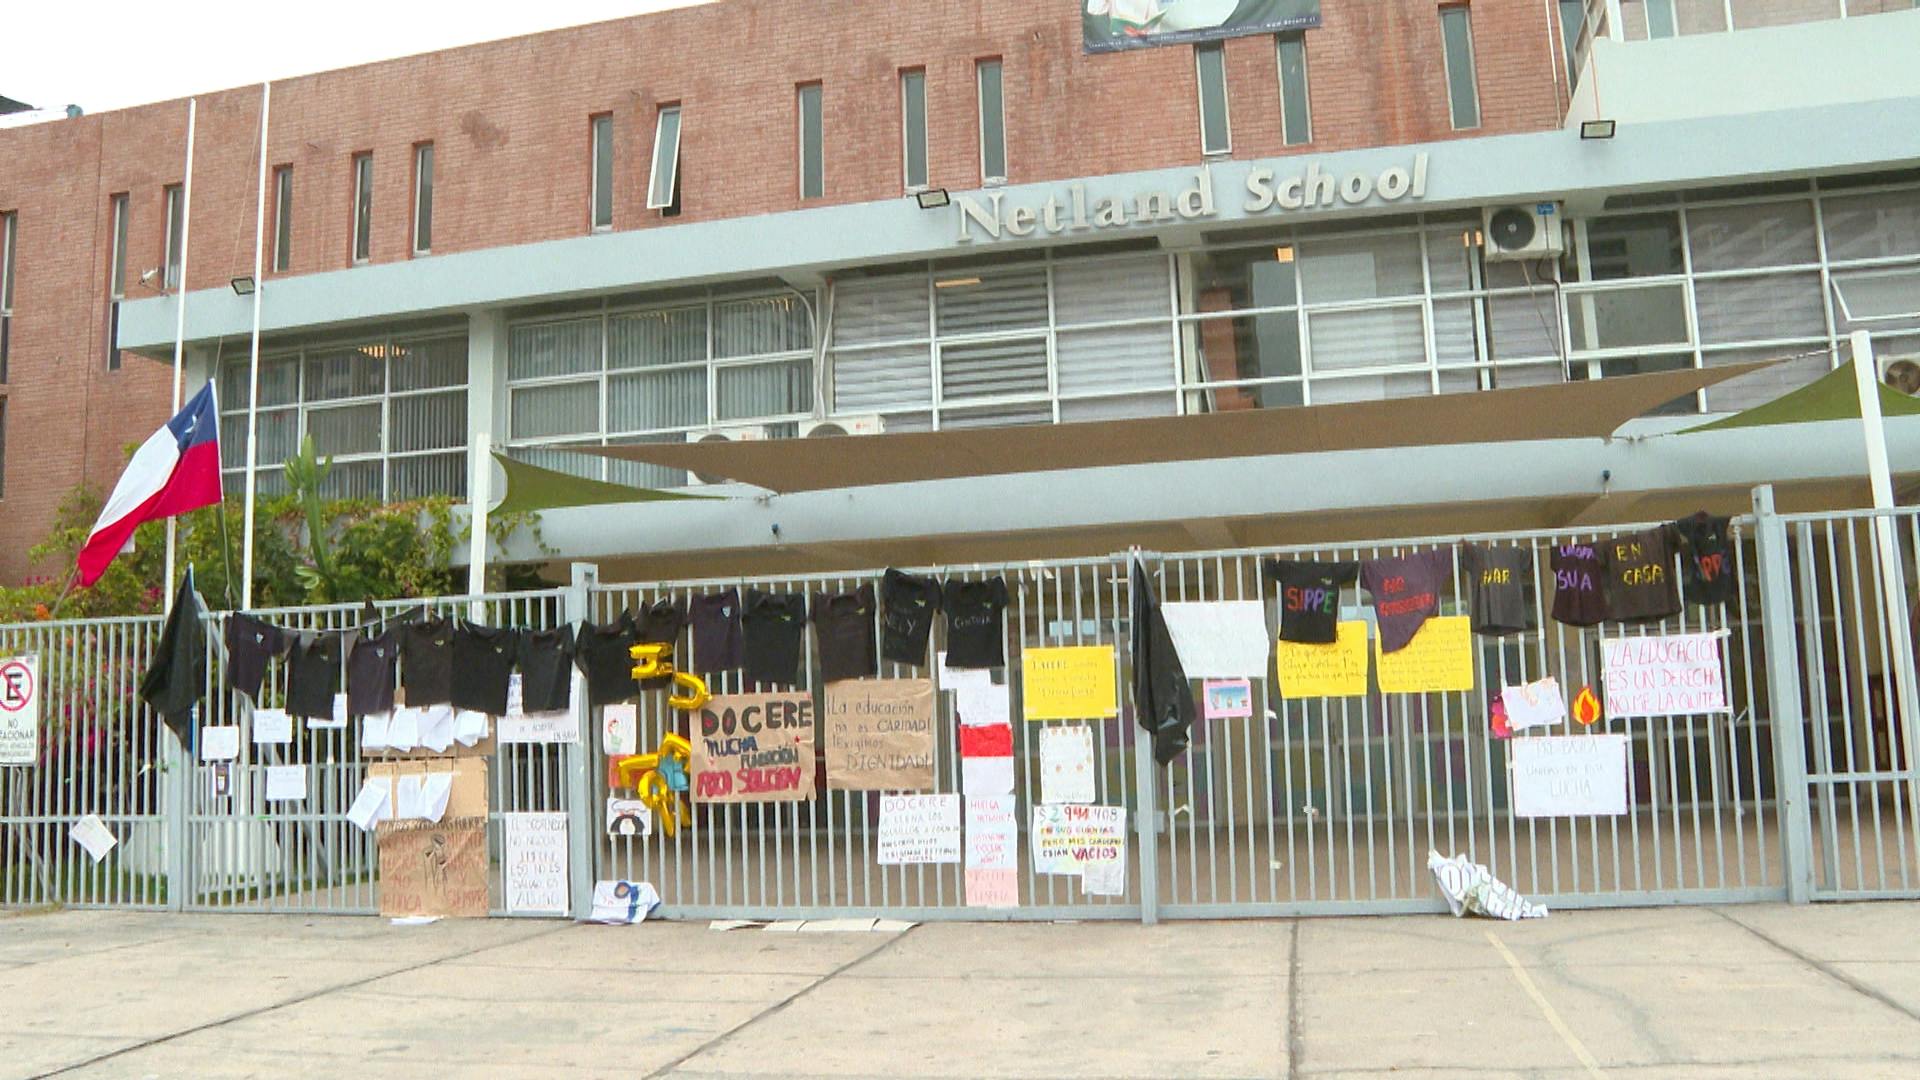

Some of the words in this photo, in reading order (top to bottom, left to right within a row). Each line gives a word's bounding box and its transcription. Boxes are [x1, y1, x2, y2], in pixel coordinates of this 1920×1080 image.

[953, 163, 1217, 243] Netland
[1245, 152, 1429, 212] School
[1616, 542, 1642, 561] EN
[1623, 563, 1664, 585] CASA
[1609, 671, 1629, 690] ES
[701, 700, 813, 736] DOCERE
